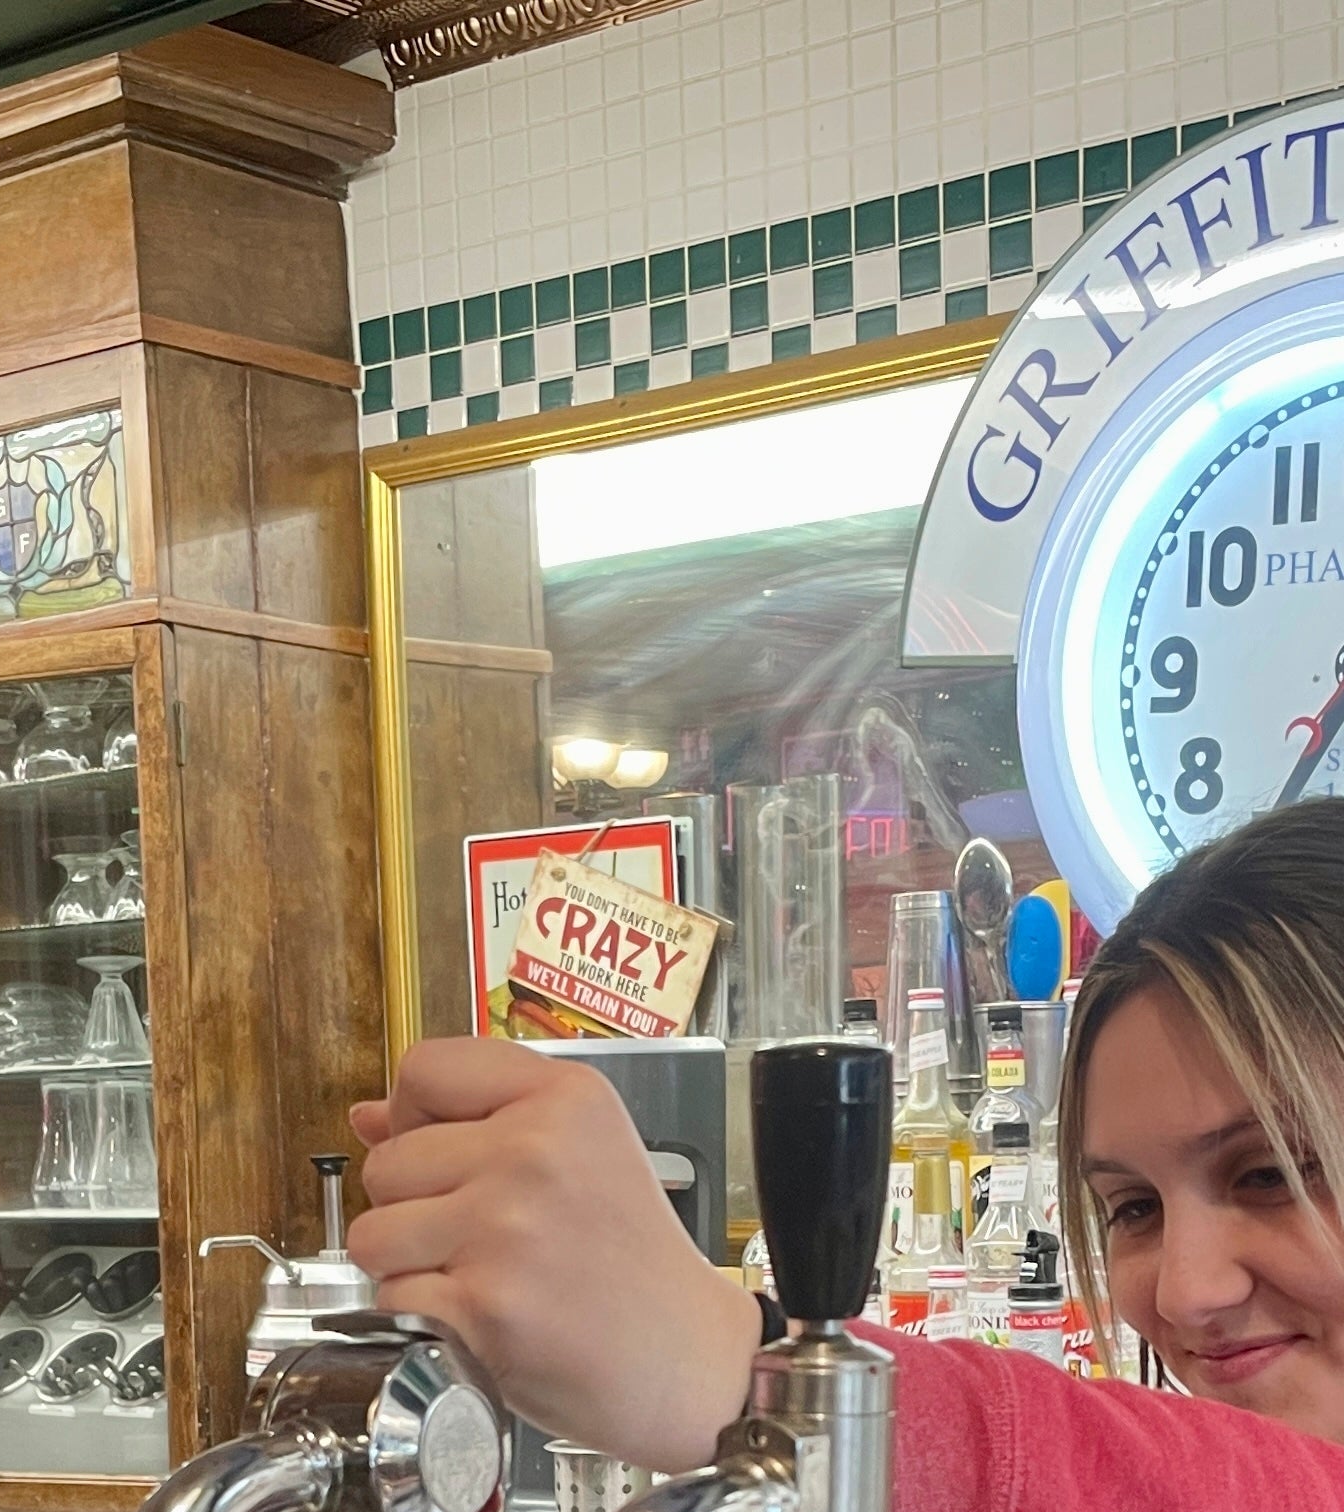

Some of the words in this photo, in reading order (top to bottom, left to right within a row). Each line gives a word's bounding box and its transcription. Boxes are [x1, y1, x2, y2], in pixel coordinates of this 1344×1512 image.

[1273, 442, 1320, 526] 11
[1185, 525, 1258, 609] 10
[1150, 635, 1199, 714] 9
[1174, 736, 1223, 816] 8
[492, 881, 528, 929] Hot
[564, 881, 586, 903] YOU
[587, 893, 619, 918] DON'T
[620, 907, 649, 932] HAVE
[650, 920, 665, 939] TO
[665, 925, 681, 946] BE
[536, 897, 688, 992] CRAZY
[558, 952, 574, 972] TO
[576, 958, 614, 988] WORK
[615, 975, 649, 1003] HERE
[527, 960, 568, 997] WE'LL
[573, 981, 620, 1019] TRAIN
[621, 1003, 658, 1037] YOU!
[1014, 1313, 1040, 1327] black
